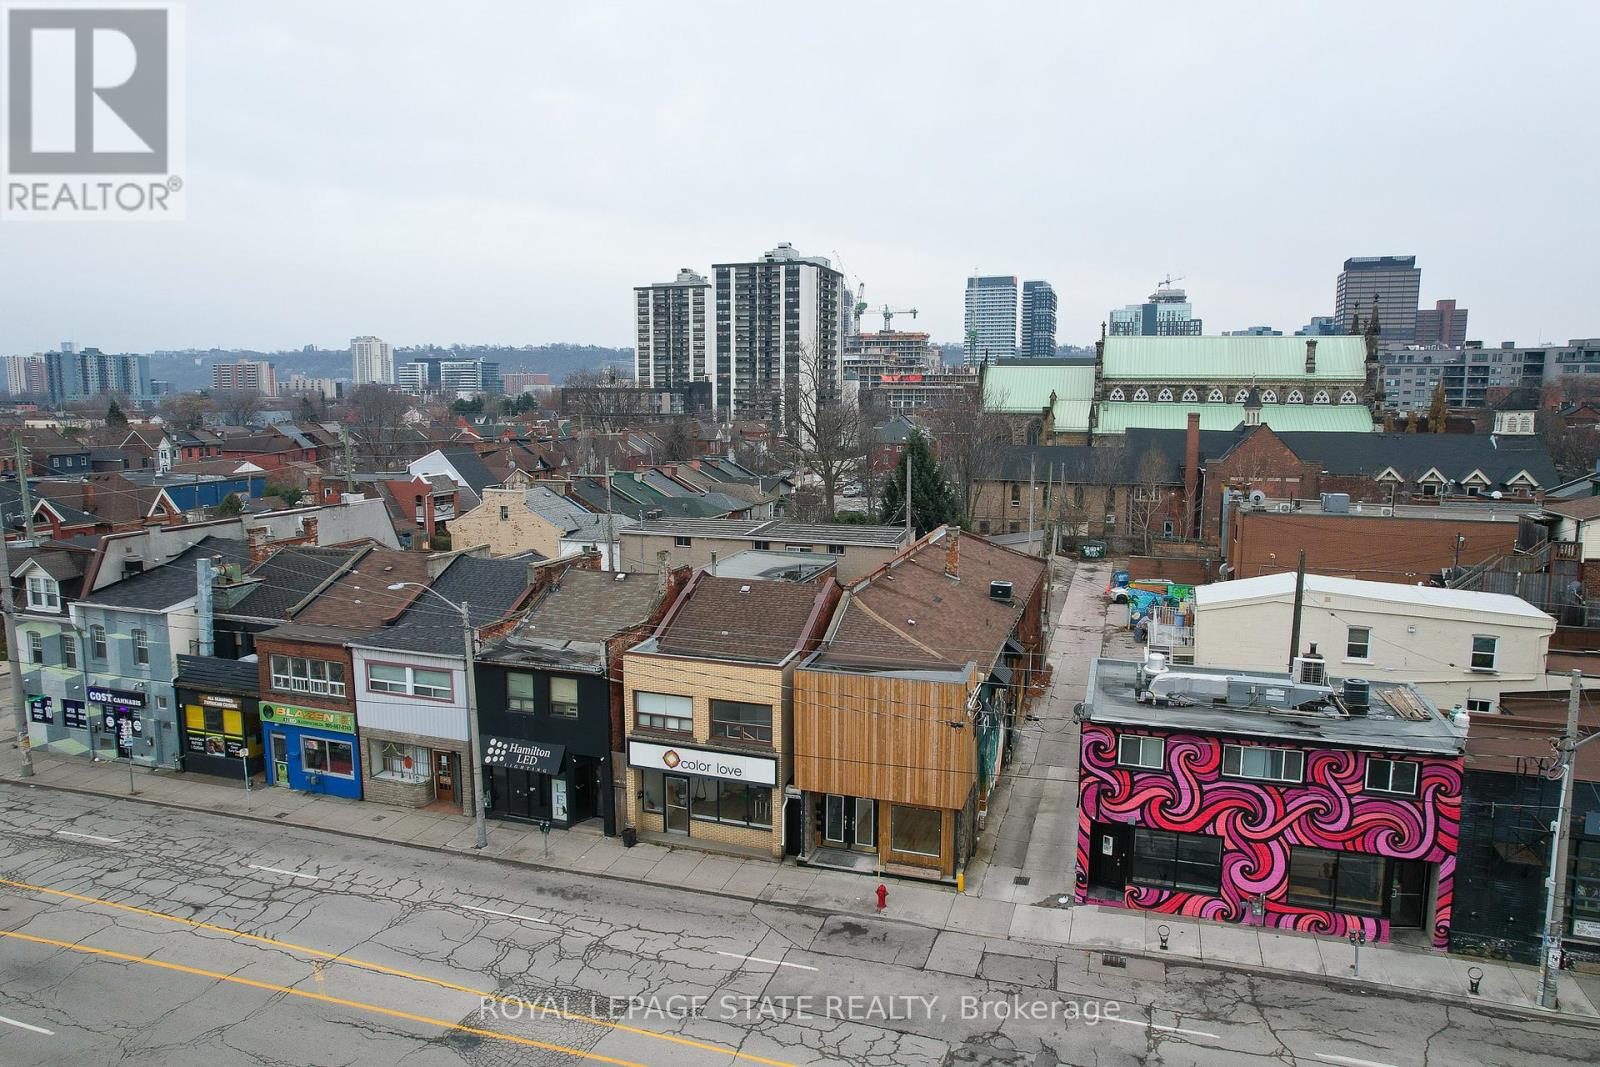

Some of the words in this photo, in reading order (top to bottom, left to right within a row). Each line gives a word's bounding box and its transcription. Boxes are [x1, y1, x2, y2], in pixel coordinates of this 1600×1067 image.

[89, 691, 113, 703] COST
[113, 697, 141, 706] CANNABIS
[274, 707, 335, 722] BLAZEN
[509, 743, 551, 758] Hamilton
[516, 754, 538, 766] LED
[504, 762, 547, 774] LIGHTING
[680, 760, 711, 772] color
[716, 762, 742, 777] love
